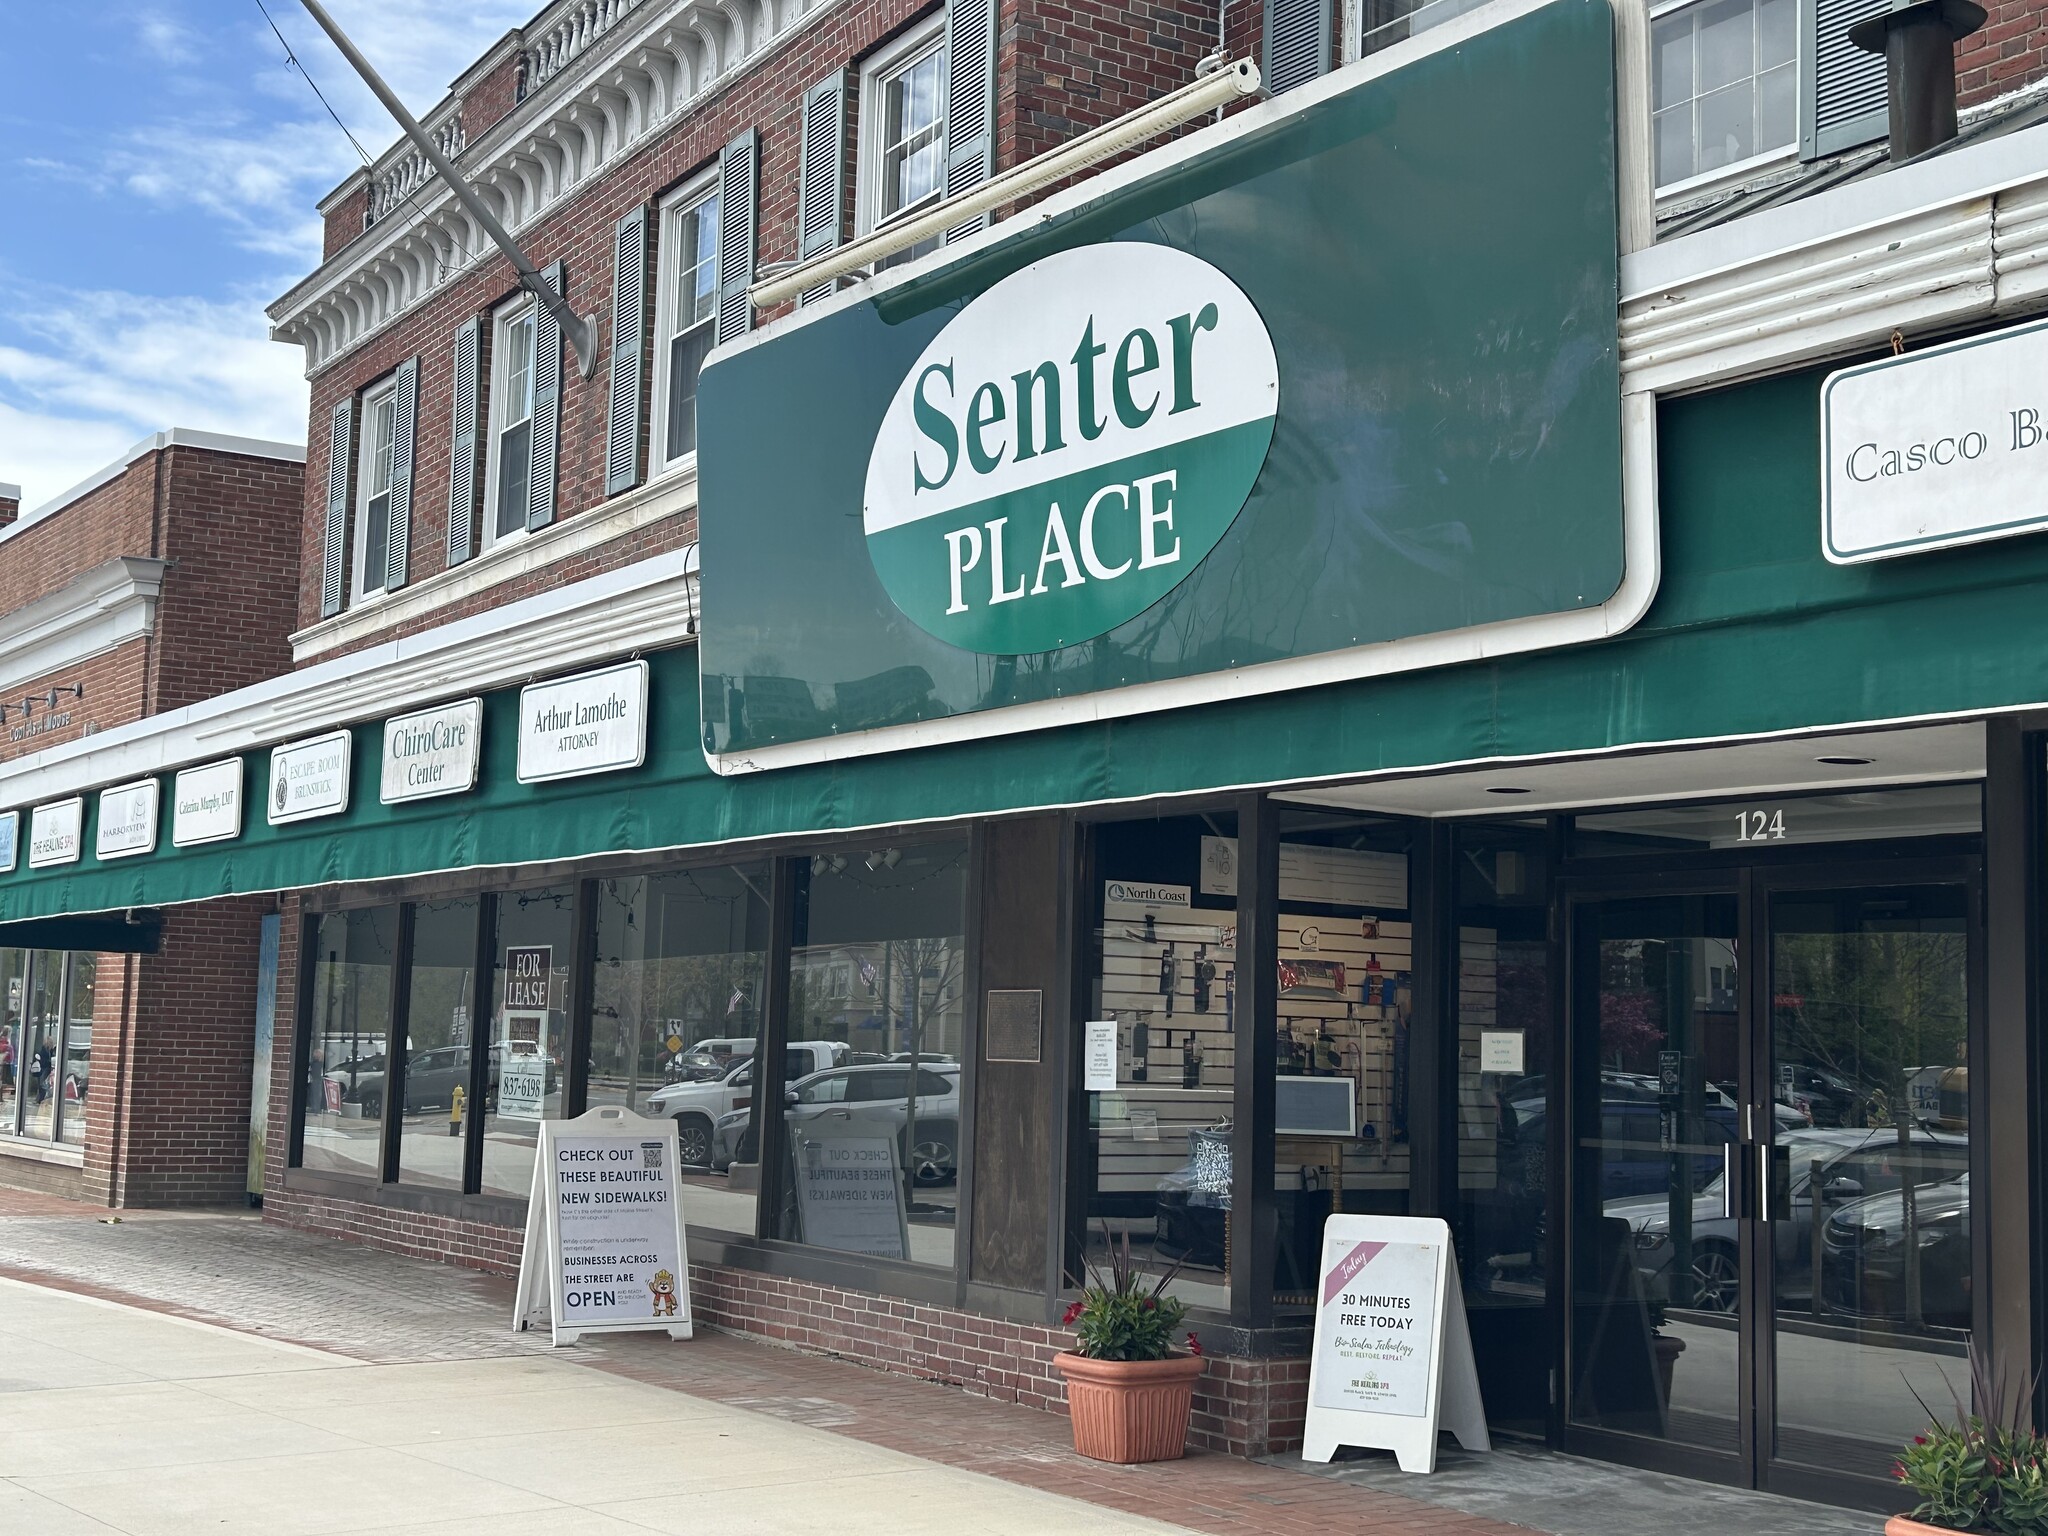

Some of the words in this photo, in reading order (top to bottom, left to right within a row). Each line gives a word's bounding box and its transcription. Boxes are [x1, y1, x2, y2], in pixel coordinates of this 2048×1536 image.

[913, 302, 1219, 496] Senter
[1846, 432, 1988, 482] Casco
[2009, 408, 2048, 452] B
[943, 469, 1181, 615] PLACE
[534, 705, 572, 734] Arthur
[575, 692, 627, 726] Lamothe
[393, 721, 466, 759] ChiroCare
[558, 731, 600, 752] ATTORNEY
[289, 761, 316, 780] ESCAPE
[318, 755, 340, 774] ROOM
[408, 763, 445, 786] Center
[294, 779, 332, 800] BRUNSWICK
[103, 822, 147, 838] HARBORVIEW
[1735, 809, 1786, 841] 124
[1126, 886, 1156, 900] North
[1158, 888, 1186, 902] Coast
[515, 953, 541, 978] FOR
[508, 981, 546, 1006] LEASE
[559, 1150, 604, 1162] CHECK
[608, 1149, 634, 1161] OUT
[559, 1171, 596, 1183] THESE
[600, 1170, 664, 1182] BEAUTIFUL
[561, 1192, 590, 1204] NEW
[594, 1191, 667, 1203] SIDEWALKS!
[564, 1255, 617, 1266] BUSINESSES
[619, 1255, 658, 1264] ACROSS
[1340, 1251, 1368, 1280] Today
[564, 1275, 582, 1284] THE
[583, 1274, 613, 1284] STREET
[616, 1273, 634, 1282] ARE
[566, 1291, 616, 1307] OPEN
[1341, 1293, 1356, 1305] 30
[1359, 1295, 1411, 1309] MINUTES
[1340, 1314, 1366, 1327] FREE
[1369, 1316, 1413, 1330] TODAY
[1375, 1337, 1414, 1356] Technology
